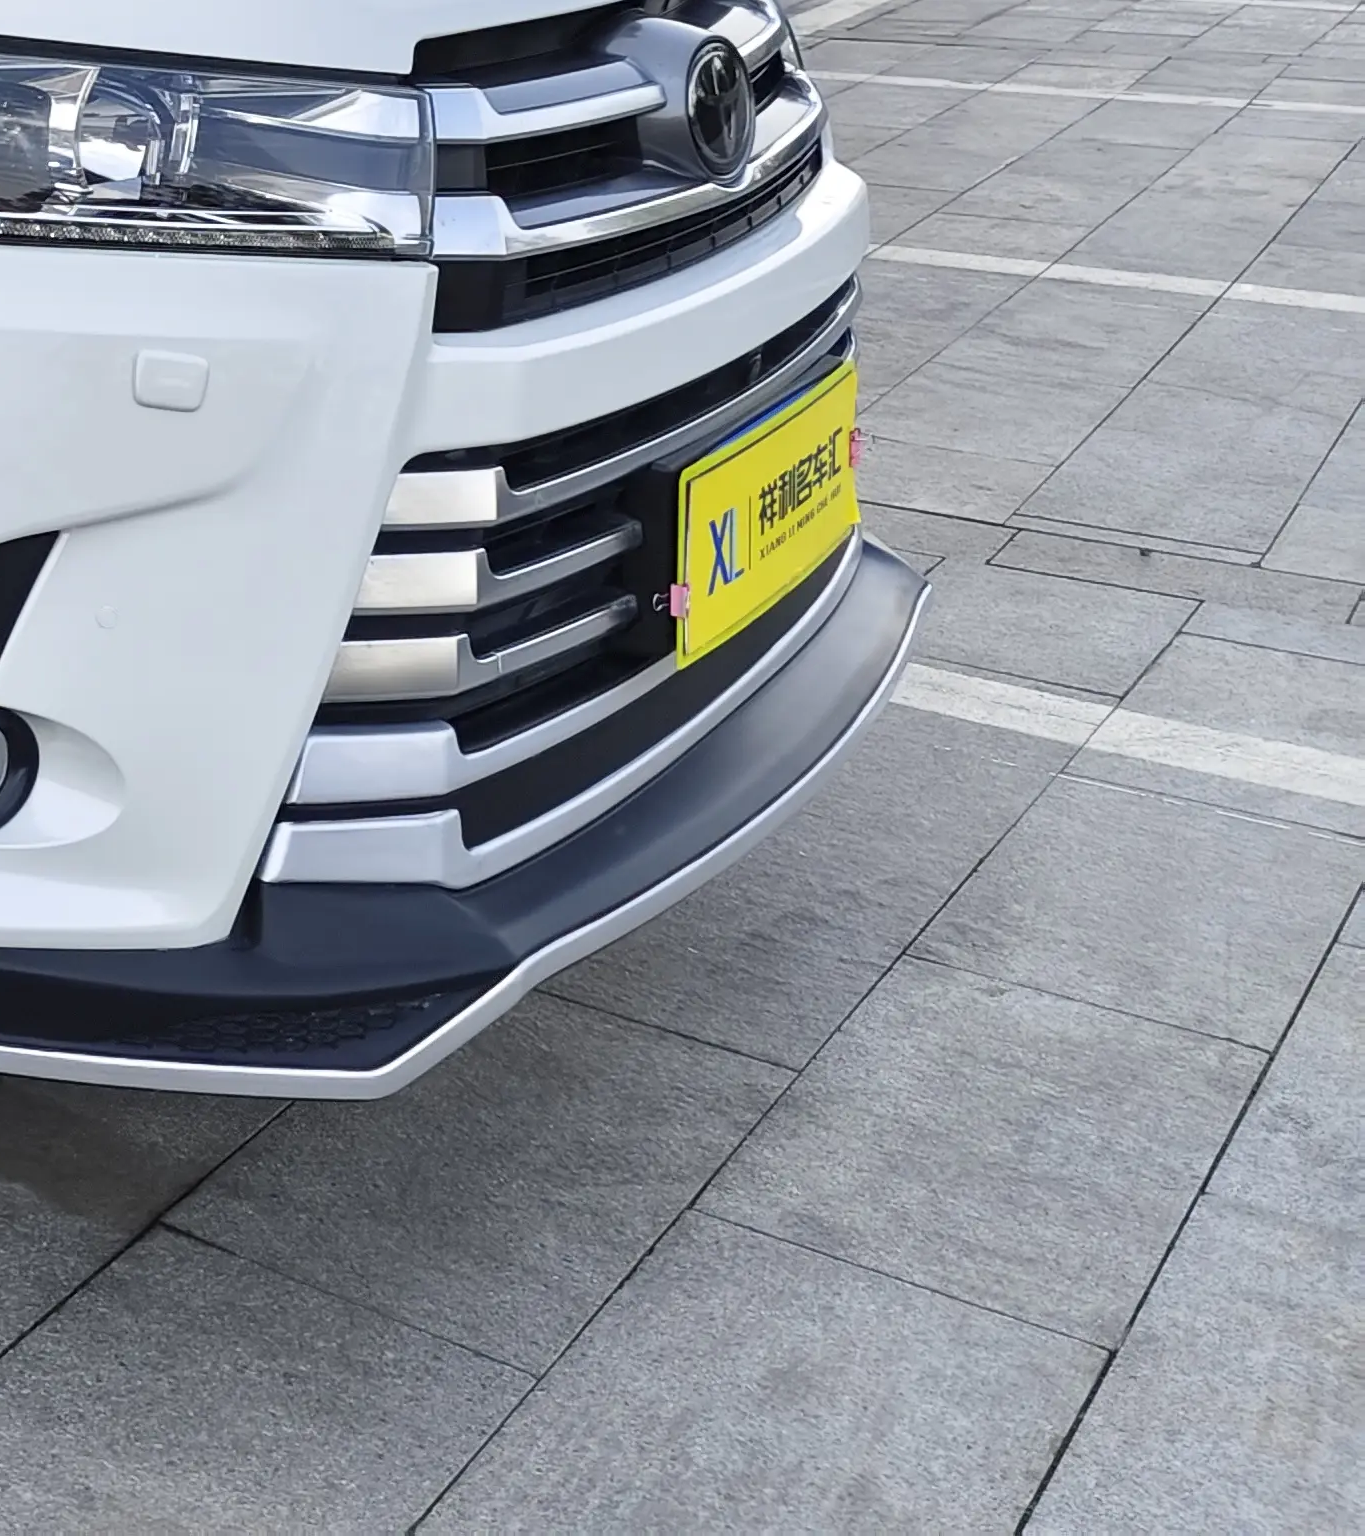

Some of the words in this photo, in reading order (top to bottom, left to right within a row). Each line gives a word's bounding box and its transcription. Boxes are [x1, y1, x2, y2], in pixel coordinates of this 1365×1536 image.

[758, 426, 842, 536] 祥利名车汇
[707, 507, 745, 596] XL
[759, 532, 786, 560] XIANG
[788, 525, 796, 539] LI
[797, 509, 815, 531] MING
[817, 496, 828, 513] CHE
